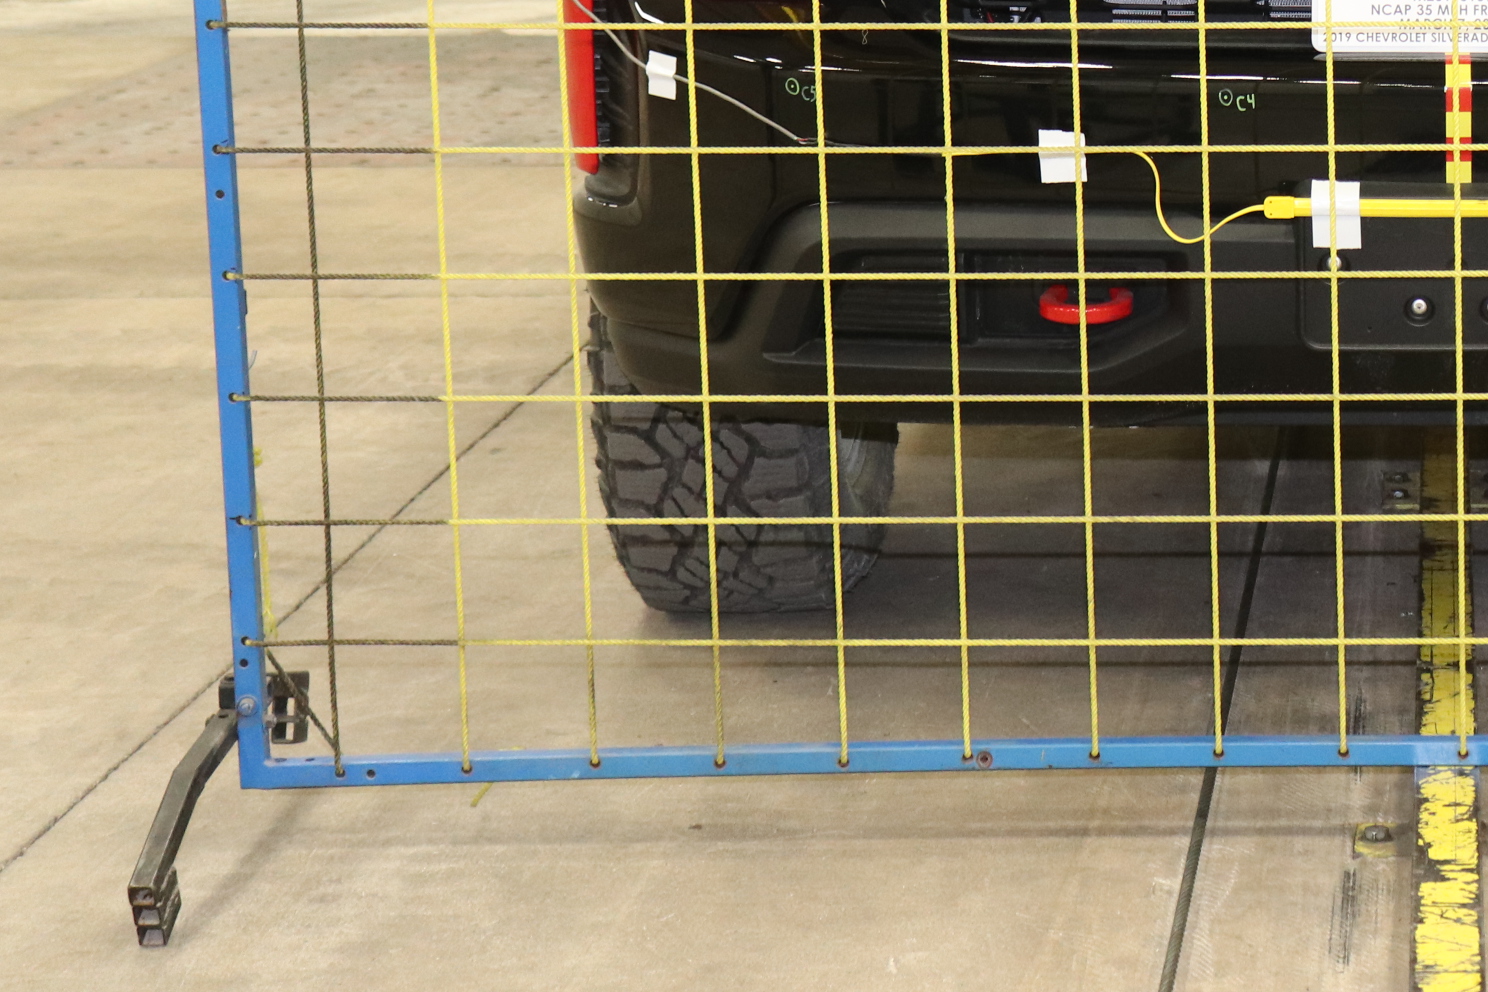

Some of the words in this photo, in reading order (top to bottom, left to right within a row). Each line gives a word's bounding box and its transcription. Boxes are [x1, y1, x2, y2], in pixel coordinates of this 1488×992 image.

[1371, 4, 1412, 16] NCAP
[1416, 4, 1433, 16] 35
[1356, 32, 1427, 43] CHEVROLET
